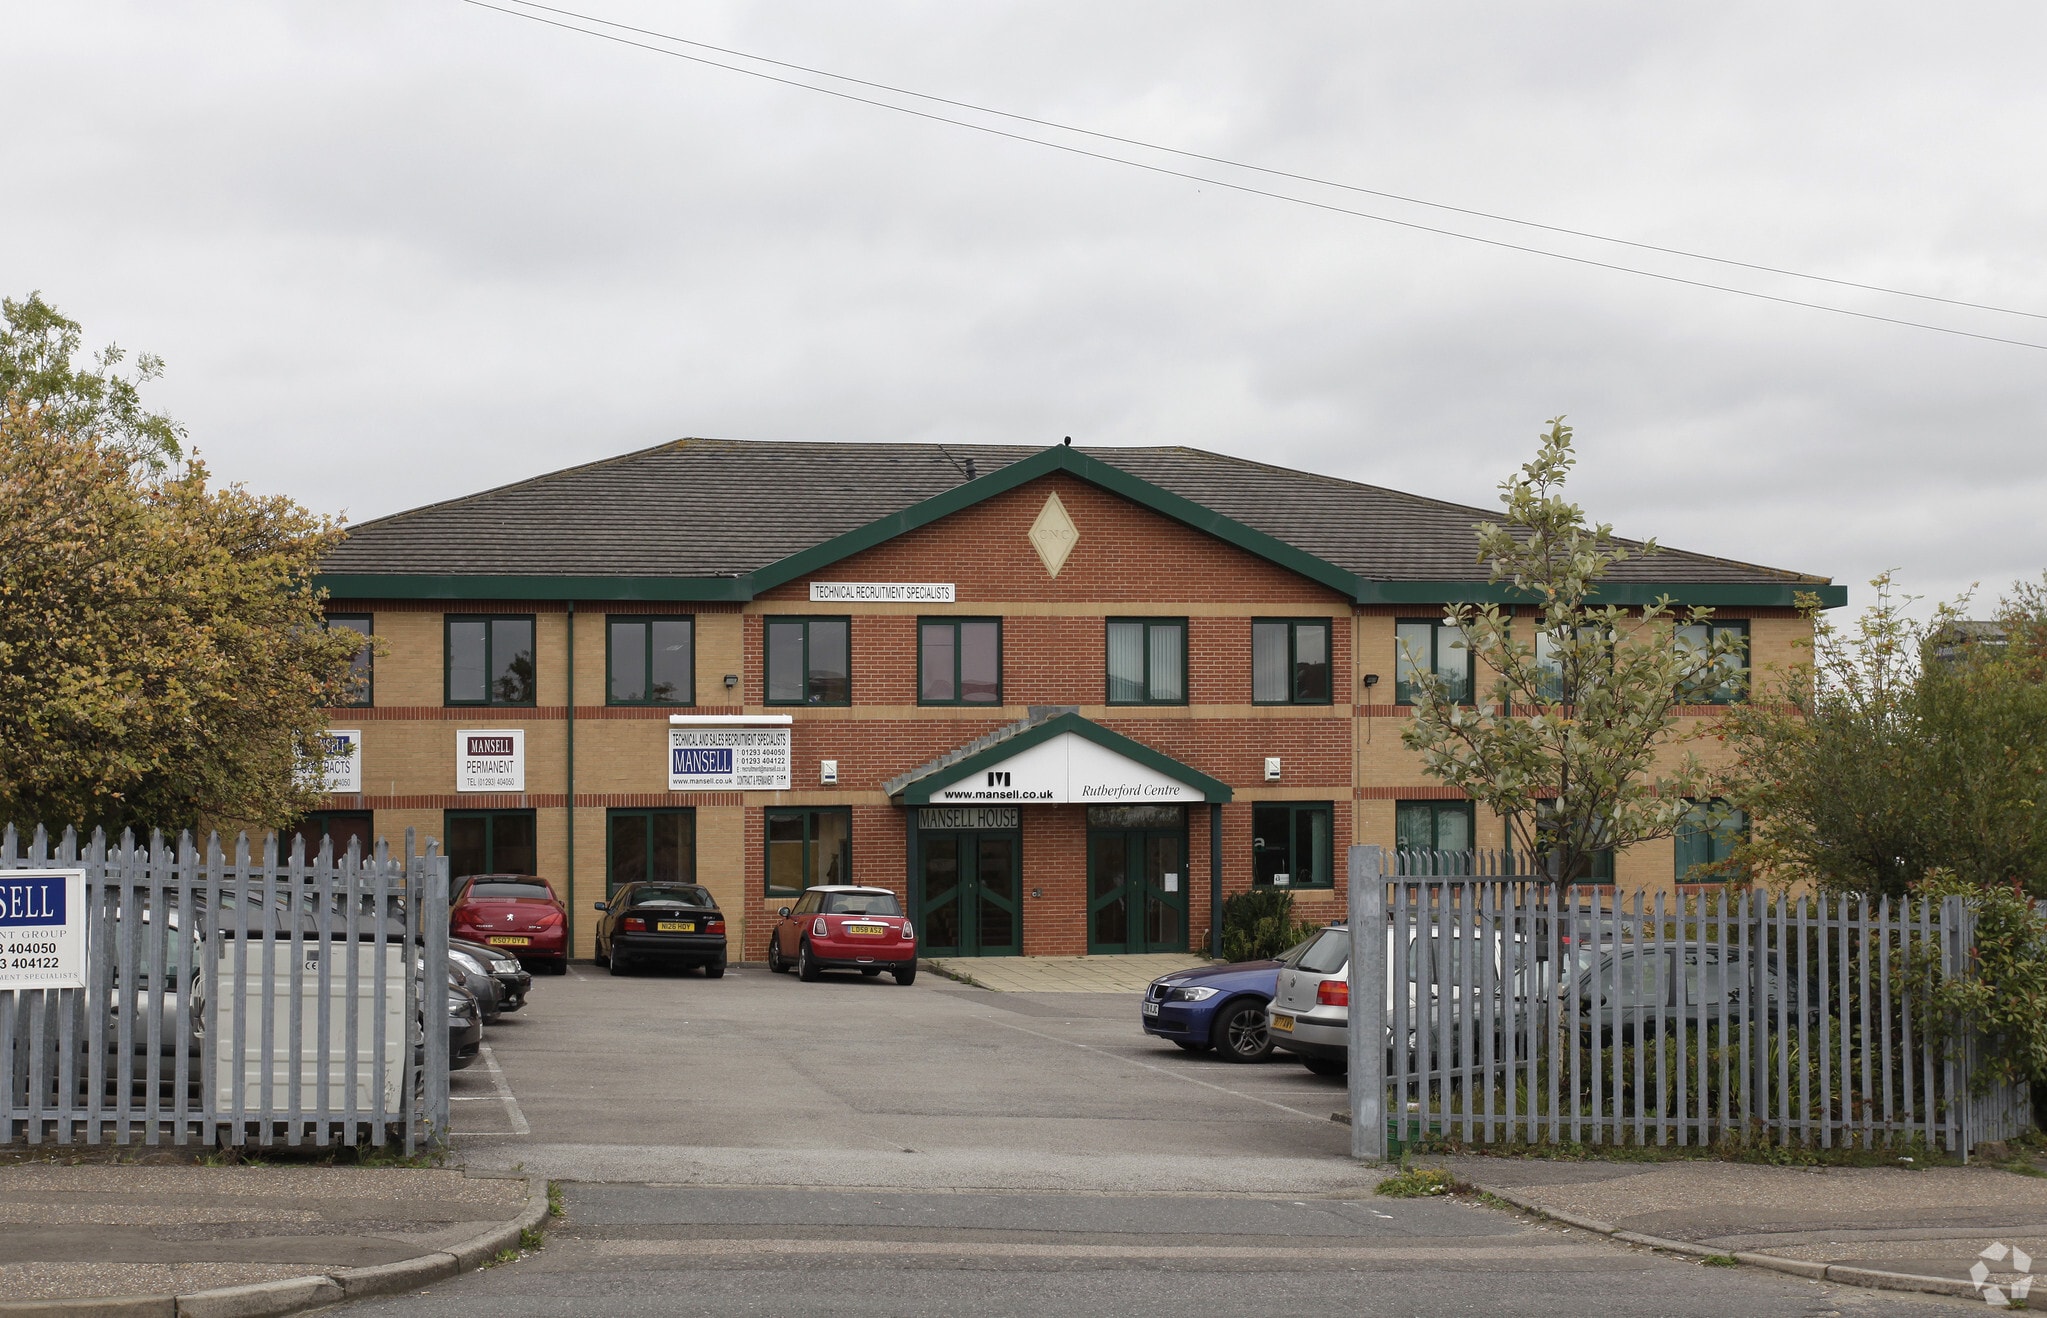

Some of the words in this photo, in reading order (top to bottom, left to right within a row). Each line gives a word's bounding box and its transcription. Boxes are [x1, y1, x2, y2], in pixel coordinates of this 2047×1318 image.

[815, 585, 855, 599] TECHNICAL
[856, 586, 905, 599] RECRUITMENT
[906, 586, 950, 600] SPECIALISTS
[471, 739, 511, 753] MANSELL
[672, 733, 698, 746] TECHNICAL
[699, 733, 709, 746] AND
[709, 733, 725, 746] SALES
[725, 733, 757, 746] RECRUITMENT
[757, 733, 786, 746] SPECIALISTS
[466, 760, 514, 774] PERMANENT
[674, 750, 731, 773] MANSELL
[741, 757, 761, 765] 01293
[762, 757, 786, 765] 404122
[467, 777, 477, 787] TEL
[496, 777, 515, 787] 404050
[672, 776, 733, 785] www.mansell.co.uk
[944, 789, 1054, 799] www.mansell.co.uk
[1081, 783, 1142, 800] Rutherford
[1143, 784, 1181, 796] Centre
[918, 808, 975, 828] MANSELL
[977, 808, 1018, 828] HOUSE
[21, 929, 68, 940] GROUP
[7, 942, 57, 955] 404050
[11, 957, 60, 970] 404122
[24, 972, 79, 981] SPECIALISTS
